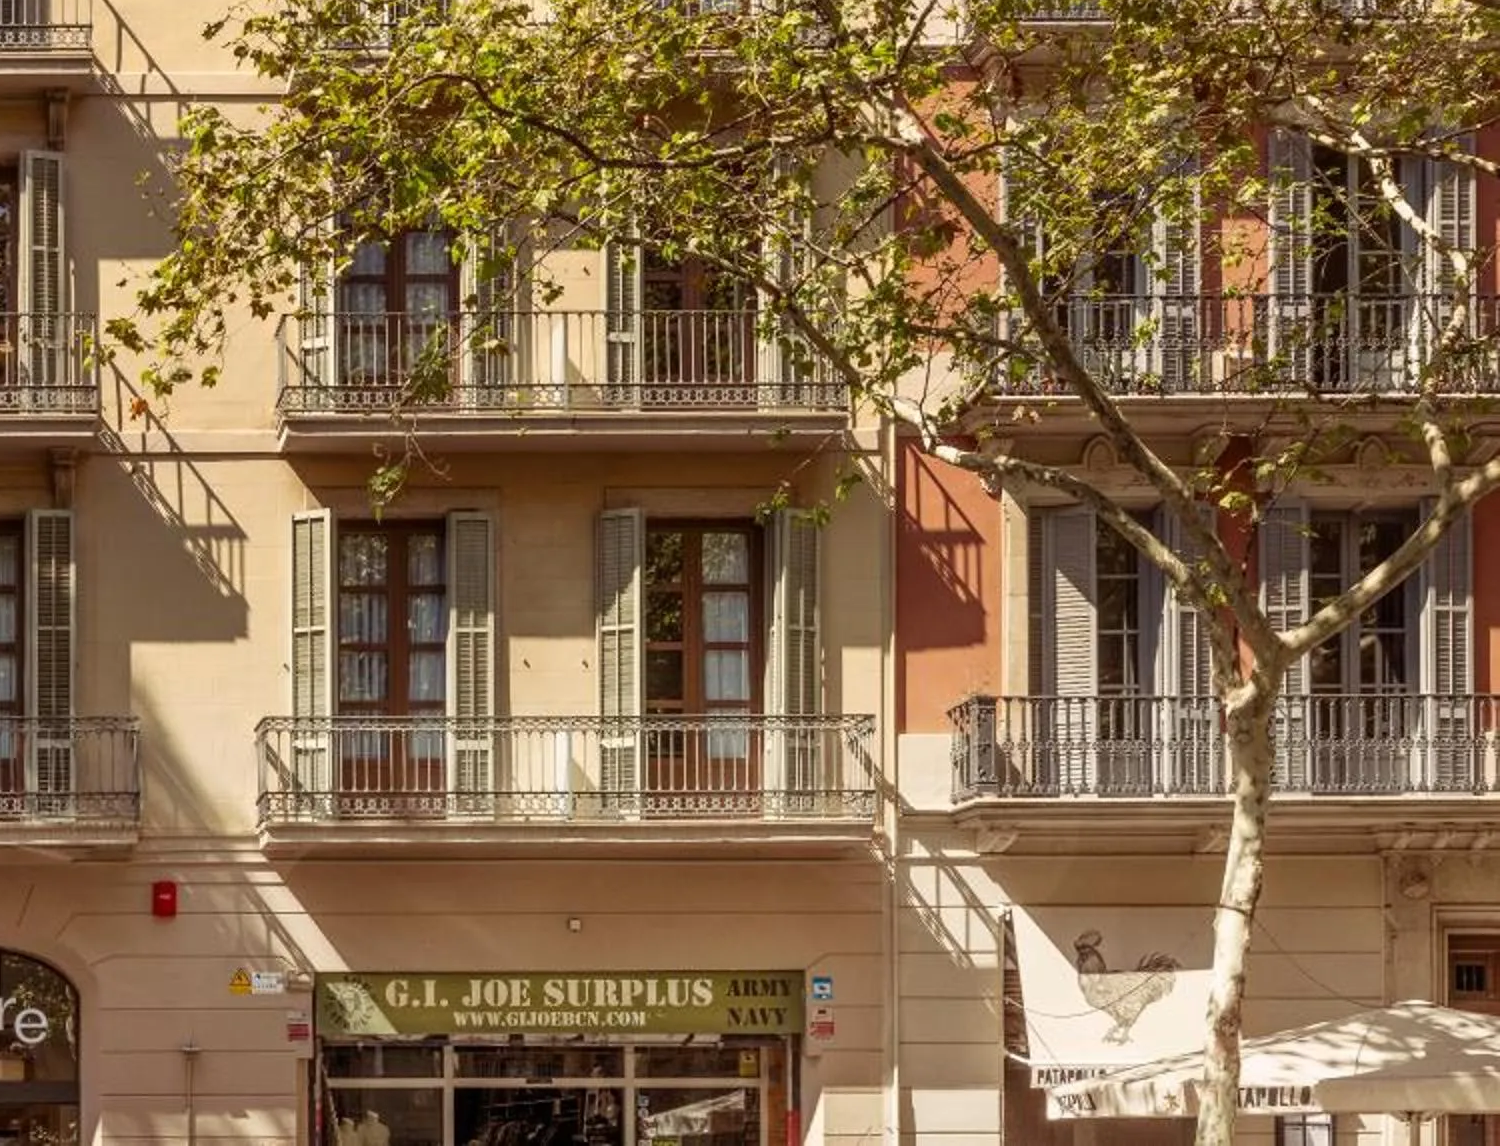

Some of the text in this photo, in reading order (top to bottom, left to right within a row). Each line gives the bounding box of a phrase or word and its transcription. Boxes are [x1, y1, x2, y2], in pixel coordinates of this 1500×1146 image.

[385, 979, 449, 1007] G.I.
[462, 979, 531, 1007] JOE
[543, 979, 713, 1007] SURPLUS
[726, 979, 793, 997] ARMY
[453, 1011, 647, 1027] WWW.GIJOEBCN.COM
[728, 1007, 788, 1026] NAVY
